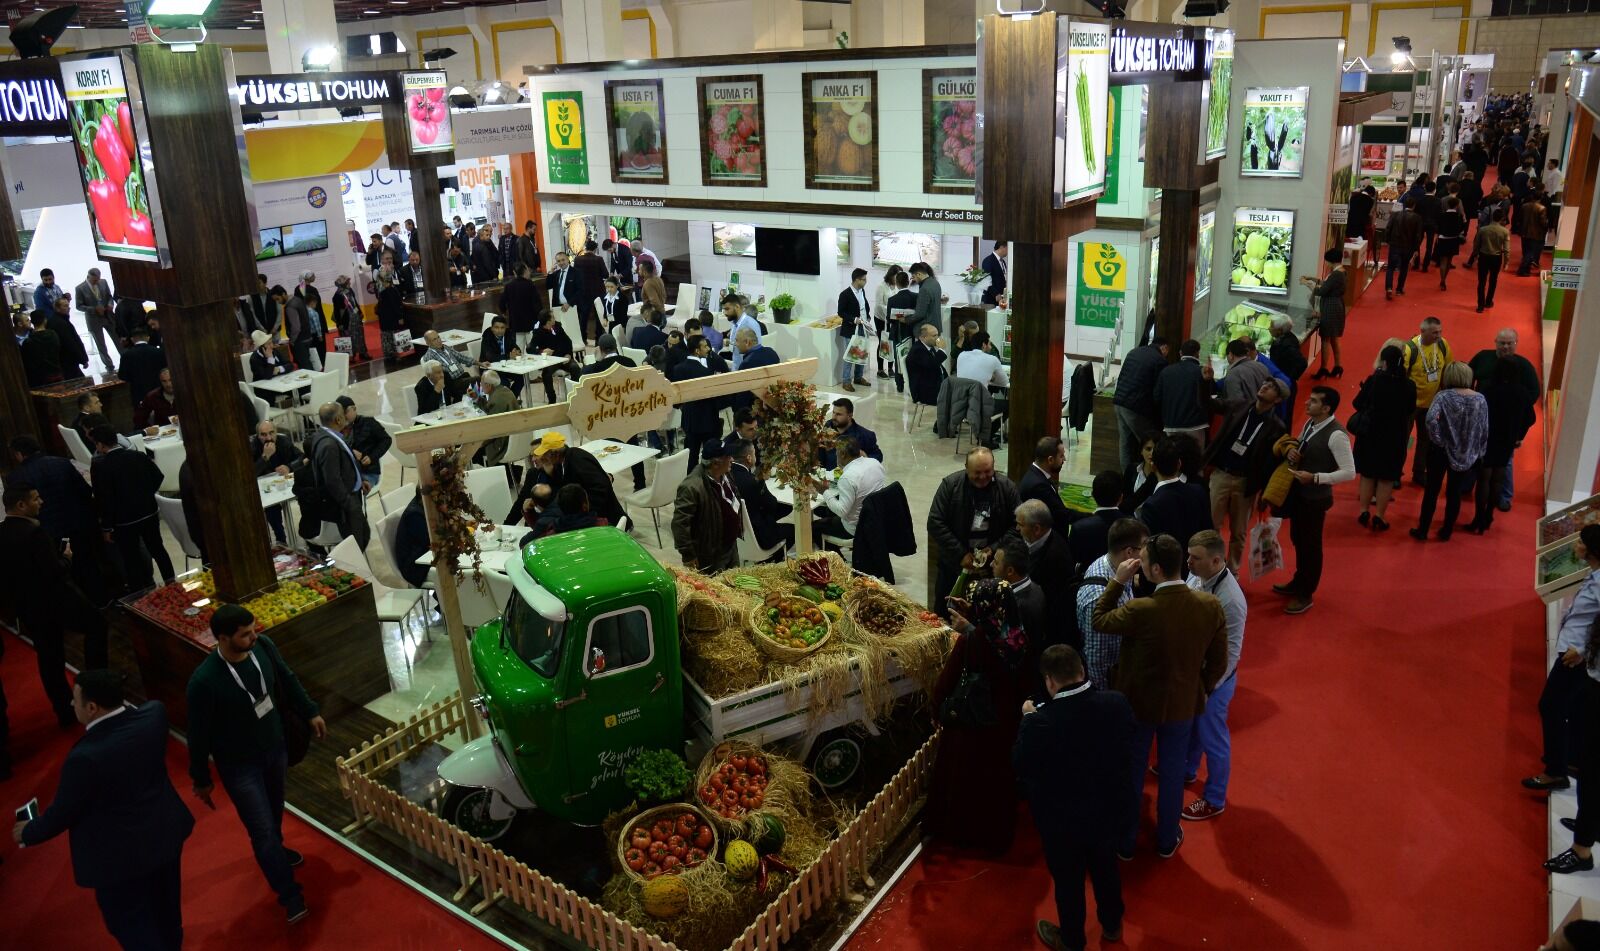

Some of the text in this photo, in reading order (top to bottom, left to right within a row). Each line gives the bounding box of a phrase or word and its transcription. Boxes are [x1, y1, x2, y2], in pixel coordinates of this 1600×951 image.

[128, 2, 143, 15] HAL
[1100, 32, 1107, 48] F1
[76, 69, 112, 88] KORAY F1
[713, 87, 754, 101] CUMA F1
[822, 84, 864, 97] ANKA F1
[937, 79, 977, 96] GÜLKÖ
[622, 90, 654, 102] USTA F1
[1259, 94, 1293, 102] YAKUT F1
[470, 124, 533, 136] TARIMSAL FİLM ÇÖZÜ
[613, 197, 632, 206] Tohum
[921, 209, 984, 221] Art of Seed Bree
[1249, 214, 1270, 222] TESLA
[1081, 293, 1124, 308] YÜKSE
[1080, 307, 1118, 322] TOHU
[591, 378, 645, 405] Köyden
[587, 391, 667, 432] gelen lezzetler
[617, 707, 641, 718] YÜKSEL
[617, 713, 641, 725] TOHUM
[597, 745, 644, 767] Köyden
[590, 767, 618, 790] gelen
